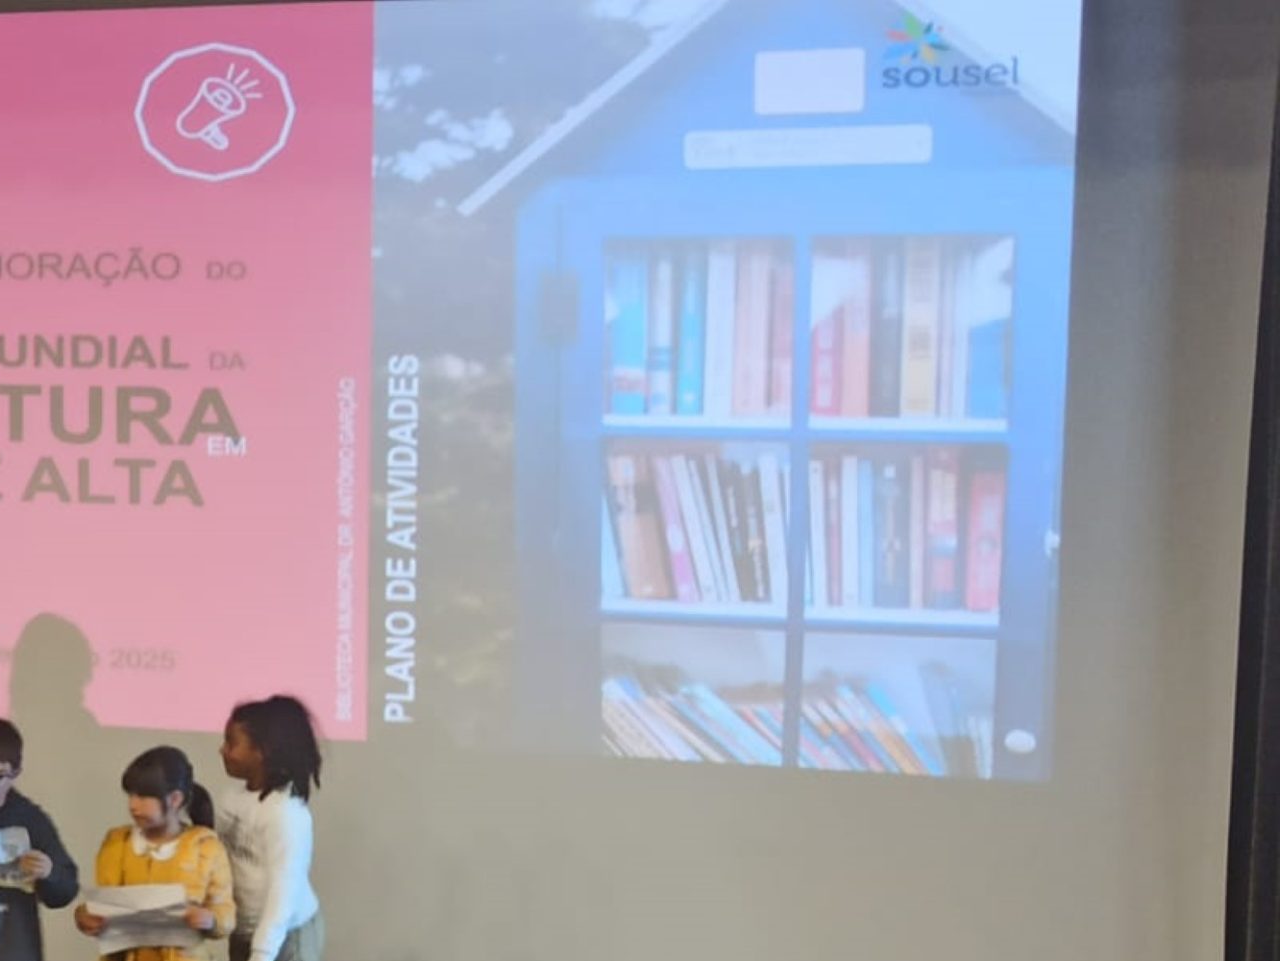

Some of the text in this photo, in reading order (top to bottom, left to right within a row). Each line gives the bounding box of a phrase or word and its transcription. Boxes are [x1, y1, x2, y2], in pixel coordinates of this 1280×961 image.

[882, 55, 1019, 89] sousel
[205, 260, 248, 281] DO
[208, 350, 247, 372] DA
[206, 435, 247, 457] EM
[20, 455, 206, 507] ALTA
[383, 354, 421, 724] PLANO DE ATIVIDADES
[110, 648, 176, 671] 2025
